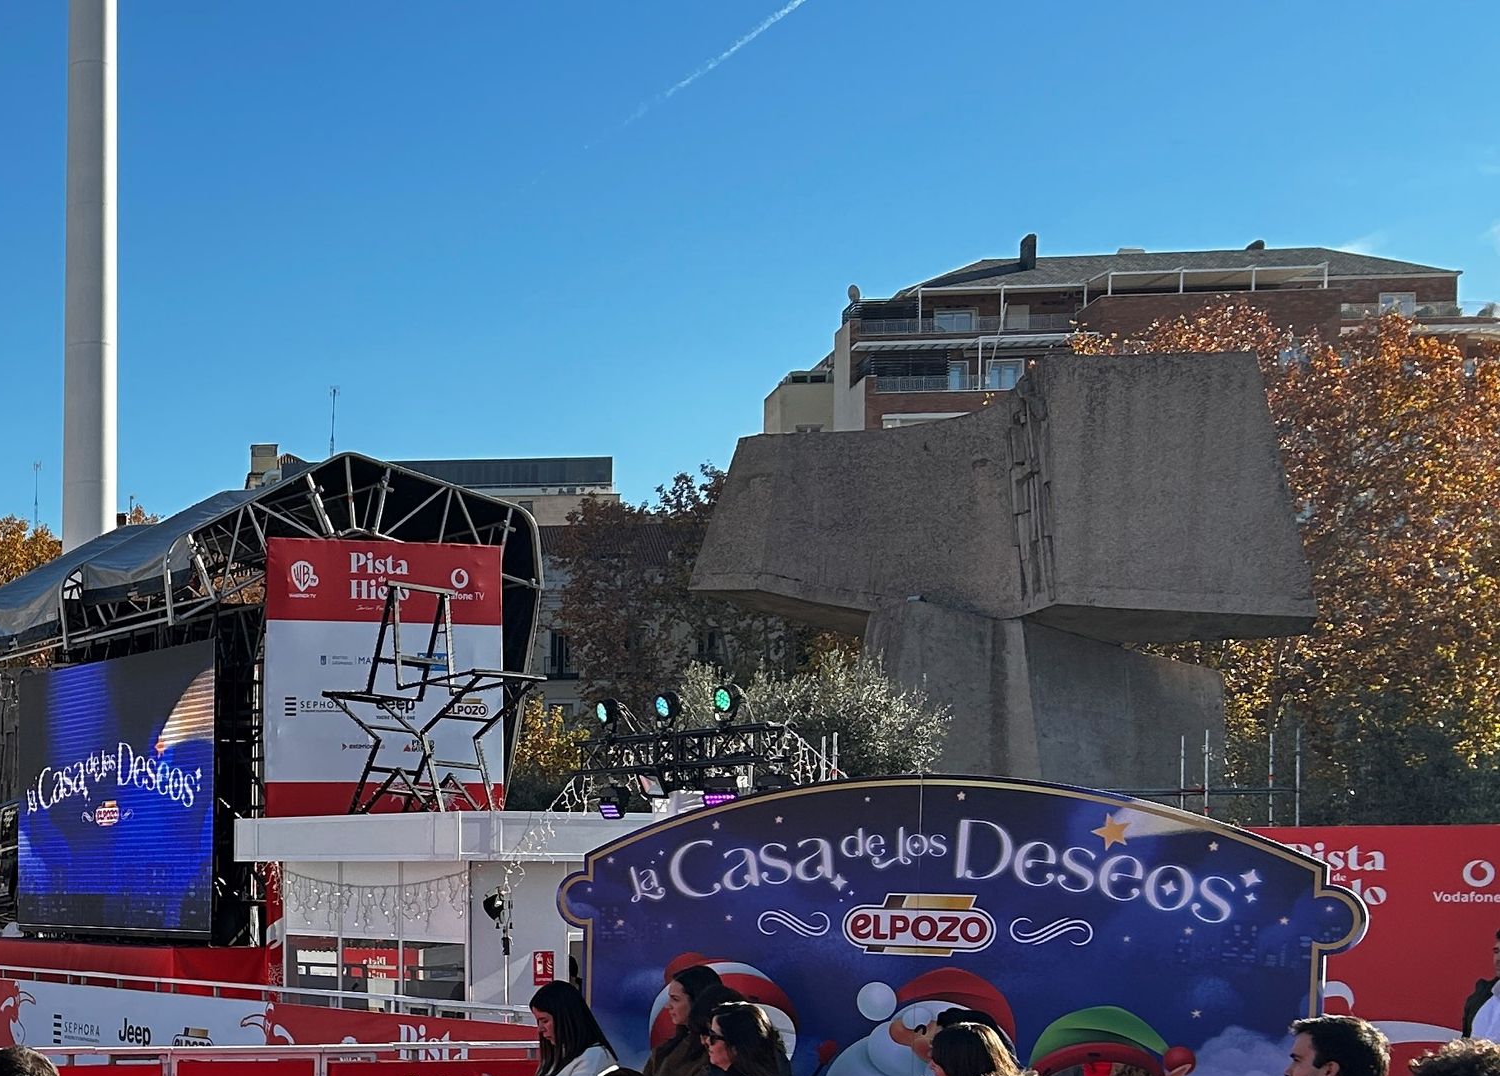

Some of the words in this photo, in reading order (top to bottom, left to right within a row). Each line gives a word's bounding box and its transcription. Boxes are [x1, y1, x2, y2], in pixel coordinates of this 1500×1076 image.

[349, 552, 409, 575] Pista
[349, 579, 411, 600] Hieo
[300, 700, 347, 710] SEPHO
[37, 761, 88, 809] Casa
[86, 752, 101, 776] de
[95, 749, 117, 782] los
[117, 742, 196, 807] Deseos
[670, 838, 834, 898] Casa
[840, 827, 887, 859] de
[871, 826, 948, 869] los
[955, 819, 1236, 923] Deseos
[1332, 873, 1347, 882] de
[63, 1021, 100, 1036] SEPHORA
[118, 1017, 151, 1047] Jeep
